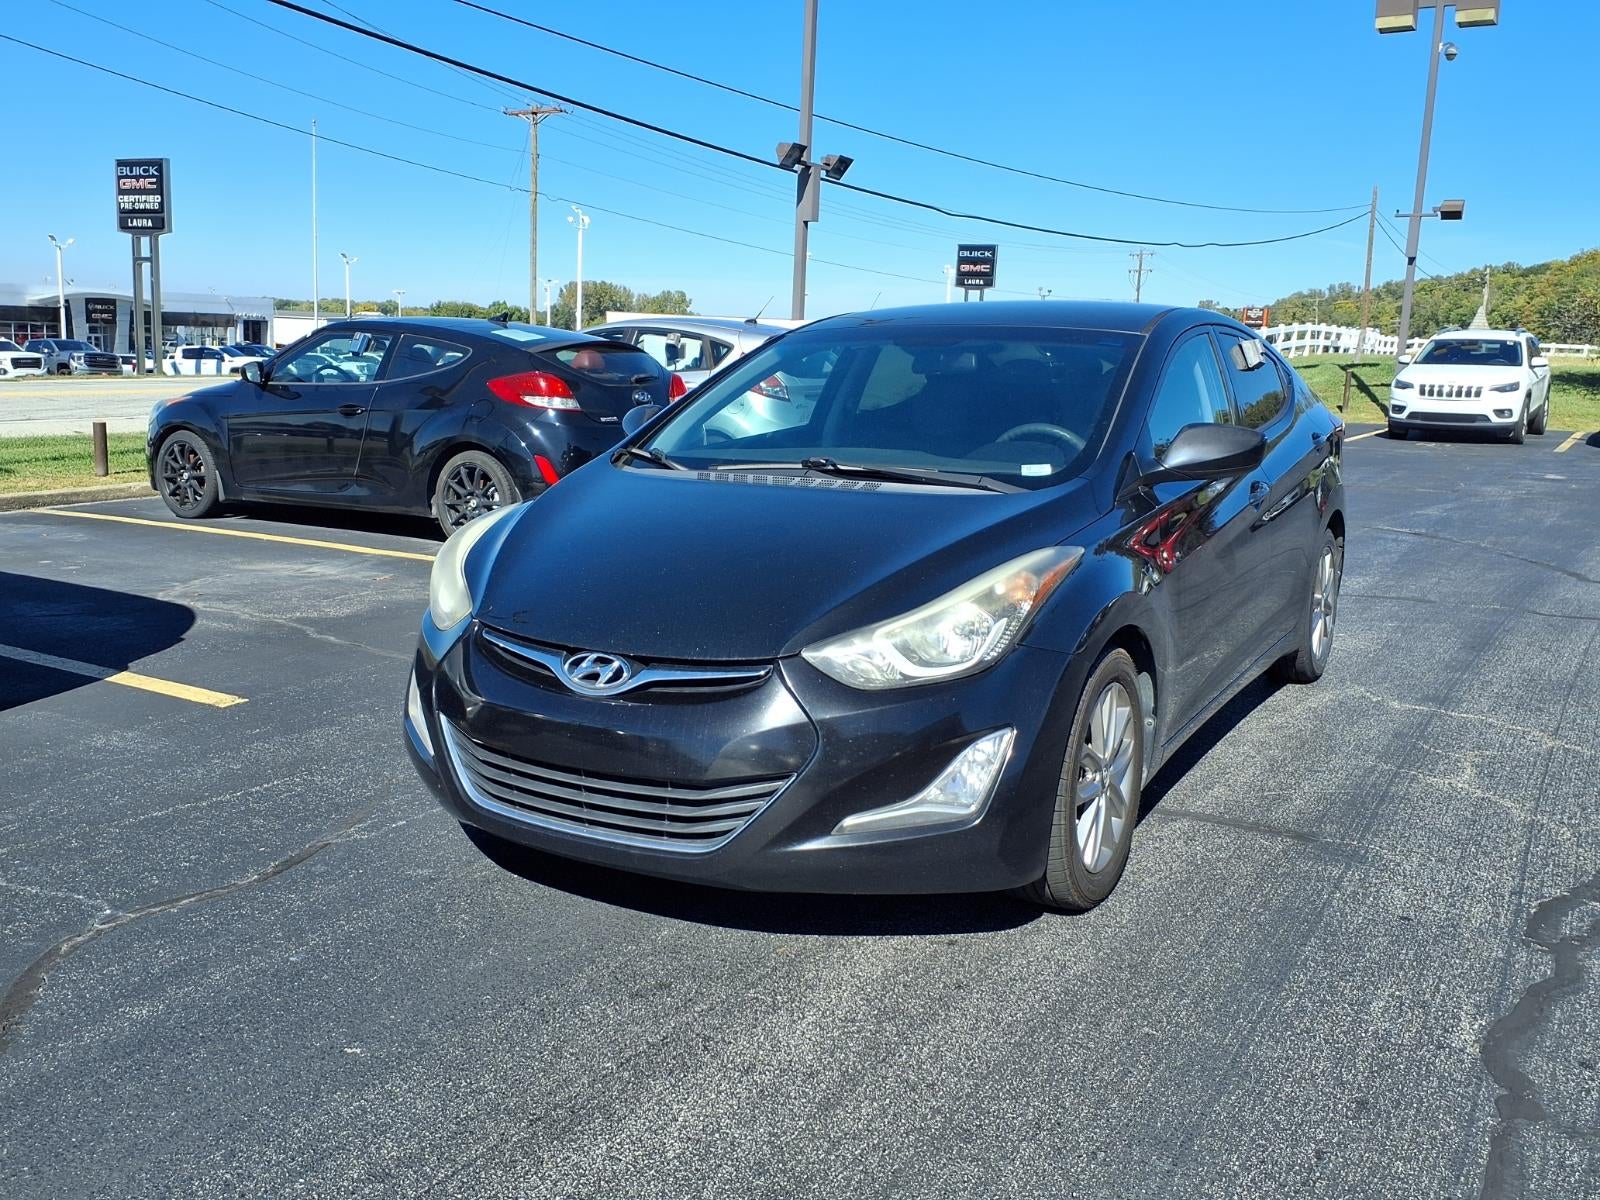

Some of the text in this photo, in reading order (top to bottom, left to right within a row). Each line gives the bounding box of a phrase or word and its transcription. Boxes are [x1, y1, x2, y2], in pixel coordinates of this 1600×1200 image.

[118, 166, 160, 176] BUICK
[120, 178, 156, 189] GMC
[128, 218, 152, 227] LAURA
